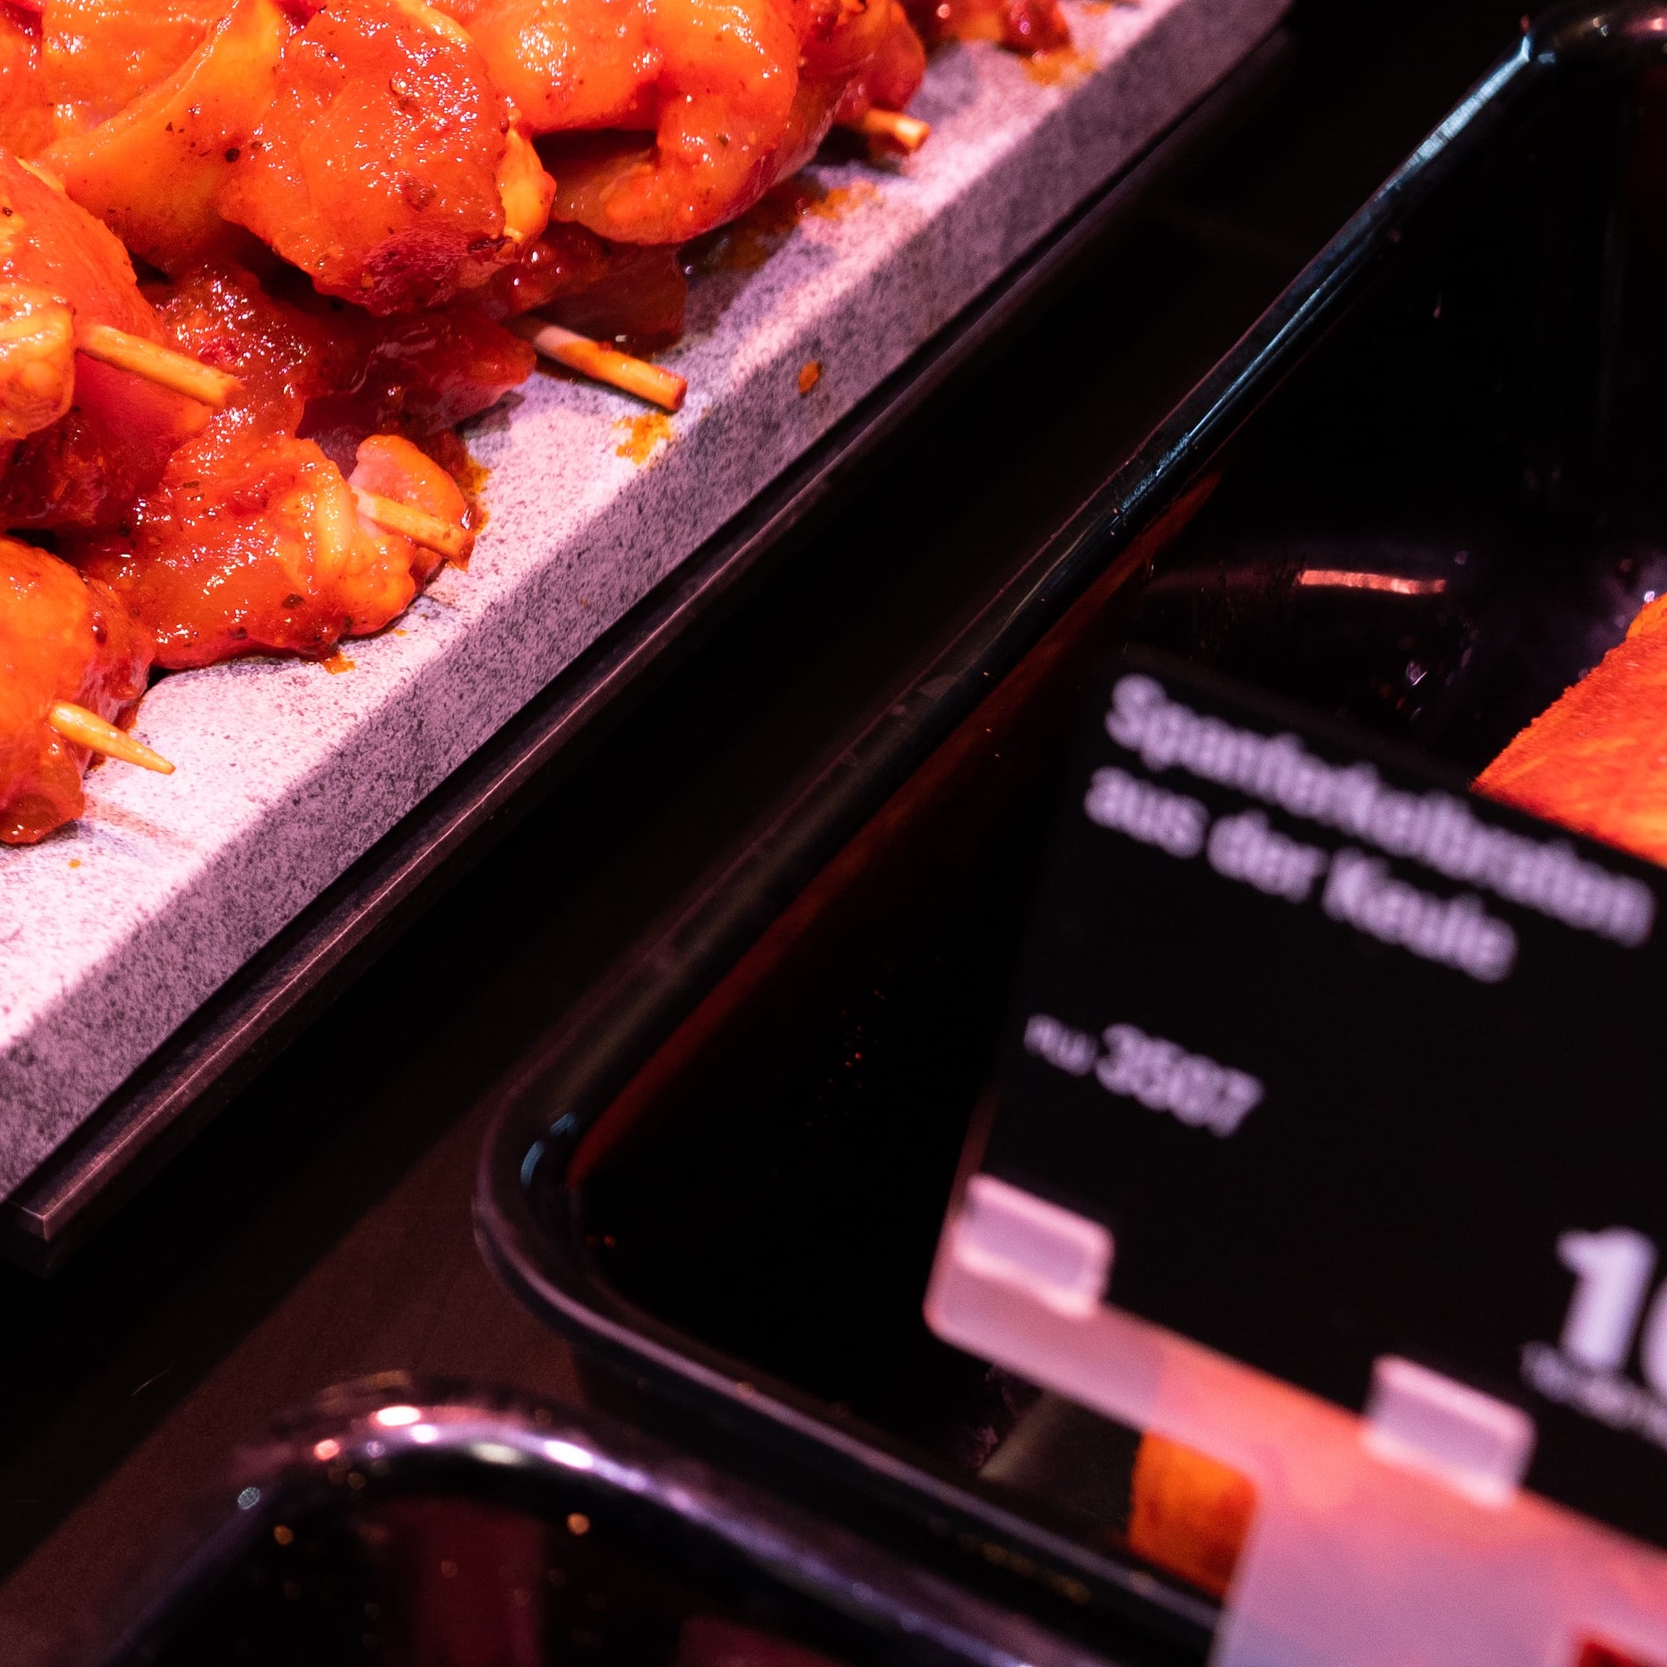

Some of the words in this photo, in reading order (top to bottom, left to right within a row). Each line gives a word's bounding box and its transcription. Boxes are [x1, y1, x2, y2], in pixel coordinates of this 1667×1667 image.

[1085, 769, 1203, 854] aus
[1208, 814, 1321, 896] der
[1323, 853, 1518, 979] Keule
[1106, 675, 1654, 943] Spanferkelbraten
[1556, 1228, 1667, 1397] 1
